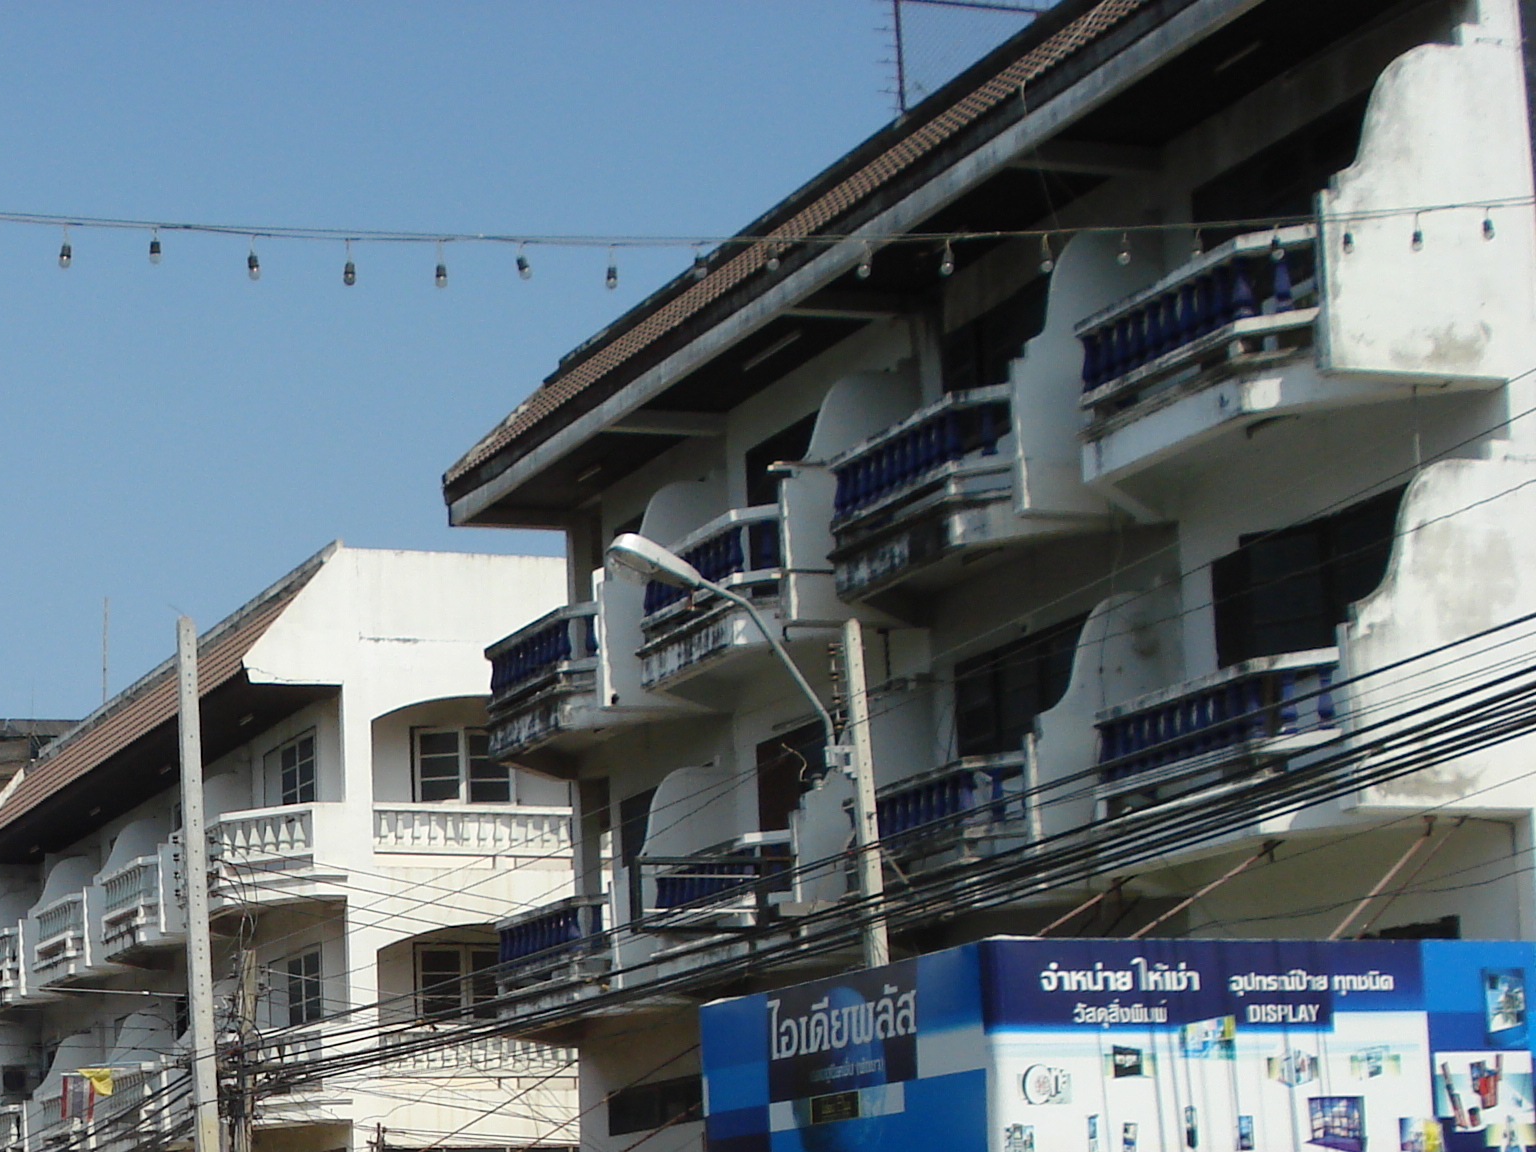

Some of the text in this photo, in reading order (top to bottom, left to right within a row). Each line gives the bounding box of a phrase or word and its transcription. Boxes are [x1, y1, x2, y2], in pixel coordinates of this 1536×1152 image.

[1040, 957, 1201, 992] จำหน่าย ให้เช่า
[1229, 968, 1394, 996] อุปกรณ์ป้าย ทุกชนิด
[766, 984, 917, 1060] ไอเดียพลัส
[1073, 998, 1167, 1028] วัสดุสิ่งพิมพ์
[1247, 1004, 1320, 1023] DISPLAY
